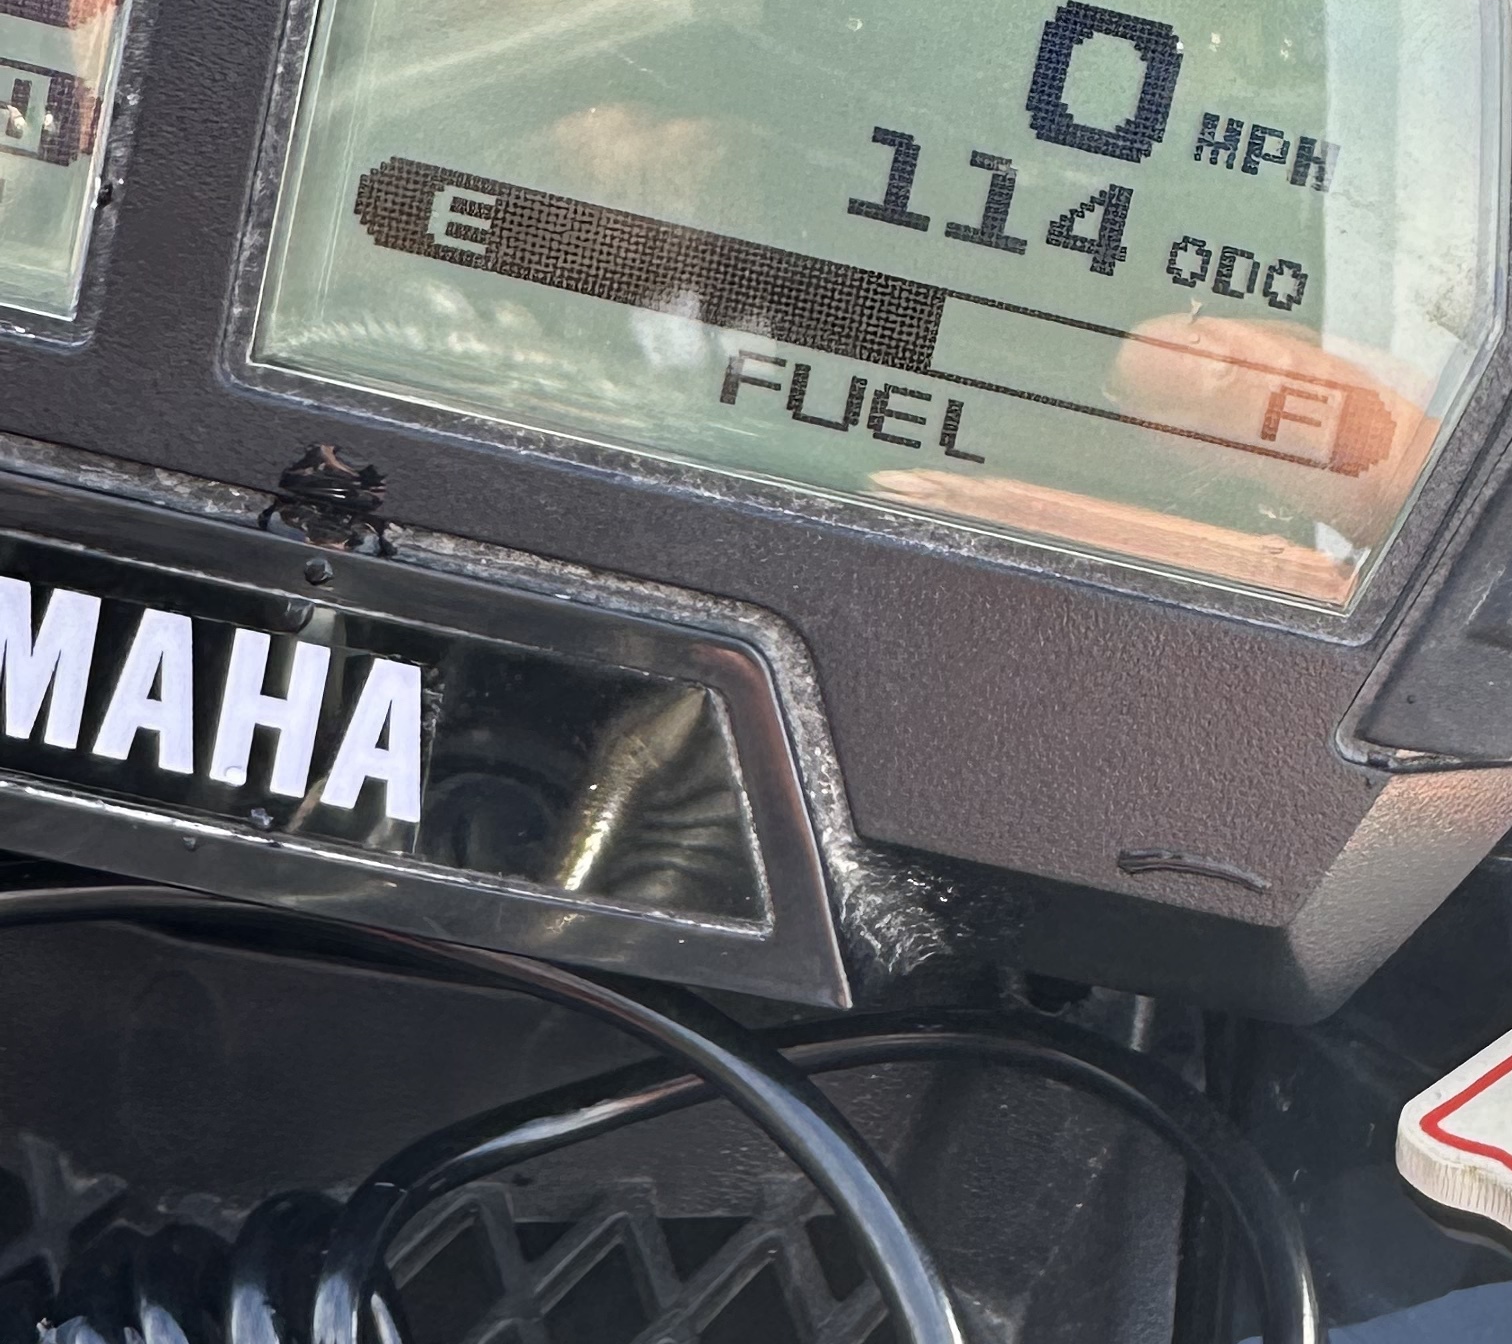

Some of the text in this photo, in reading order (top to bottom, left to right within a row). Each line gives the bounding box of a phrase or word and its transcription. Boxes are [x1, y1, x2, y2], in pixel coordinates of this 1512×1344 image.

[1026, 0, 1184, 164] 0
[1194, 112, 1341, 191] MPH
[426, 183, 498, 256] E
[847, 126, 1134, 276] 114
[1166, 235, 1309, 311] ODO
[719, 350, 985, 464] FUEL
[1261, 384, 1331, 441] F
